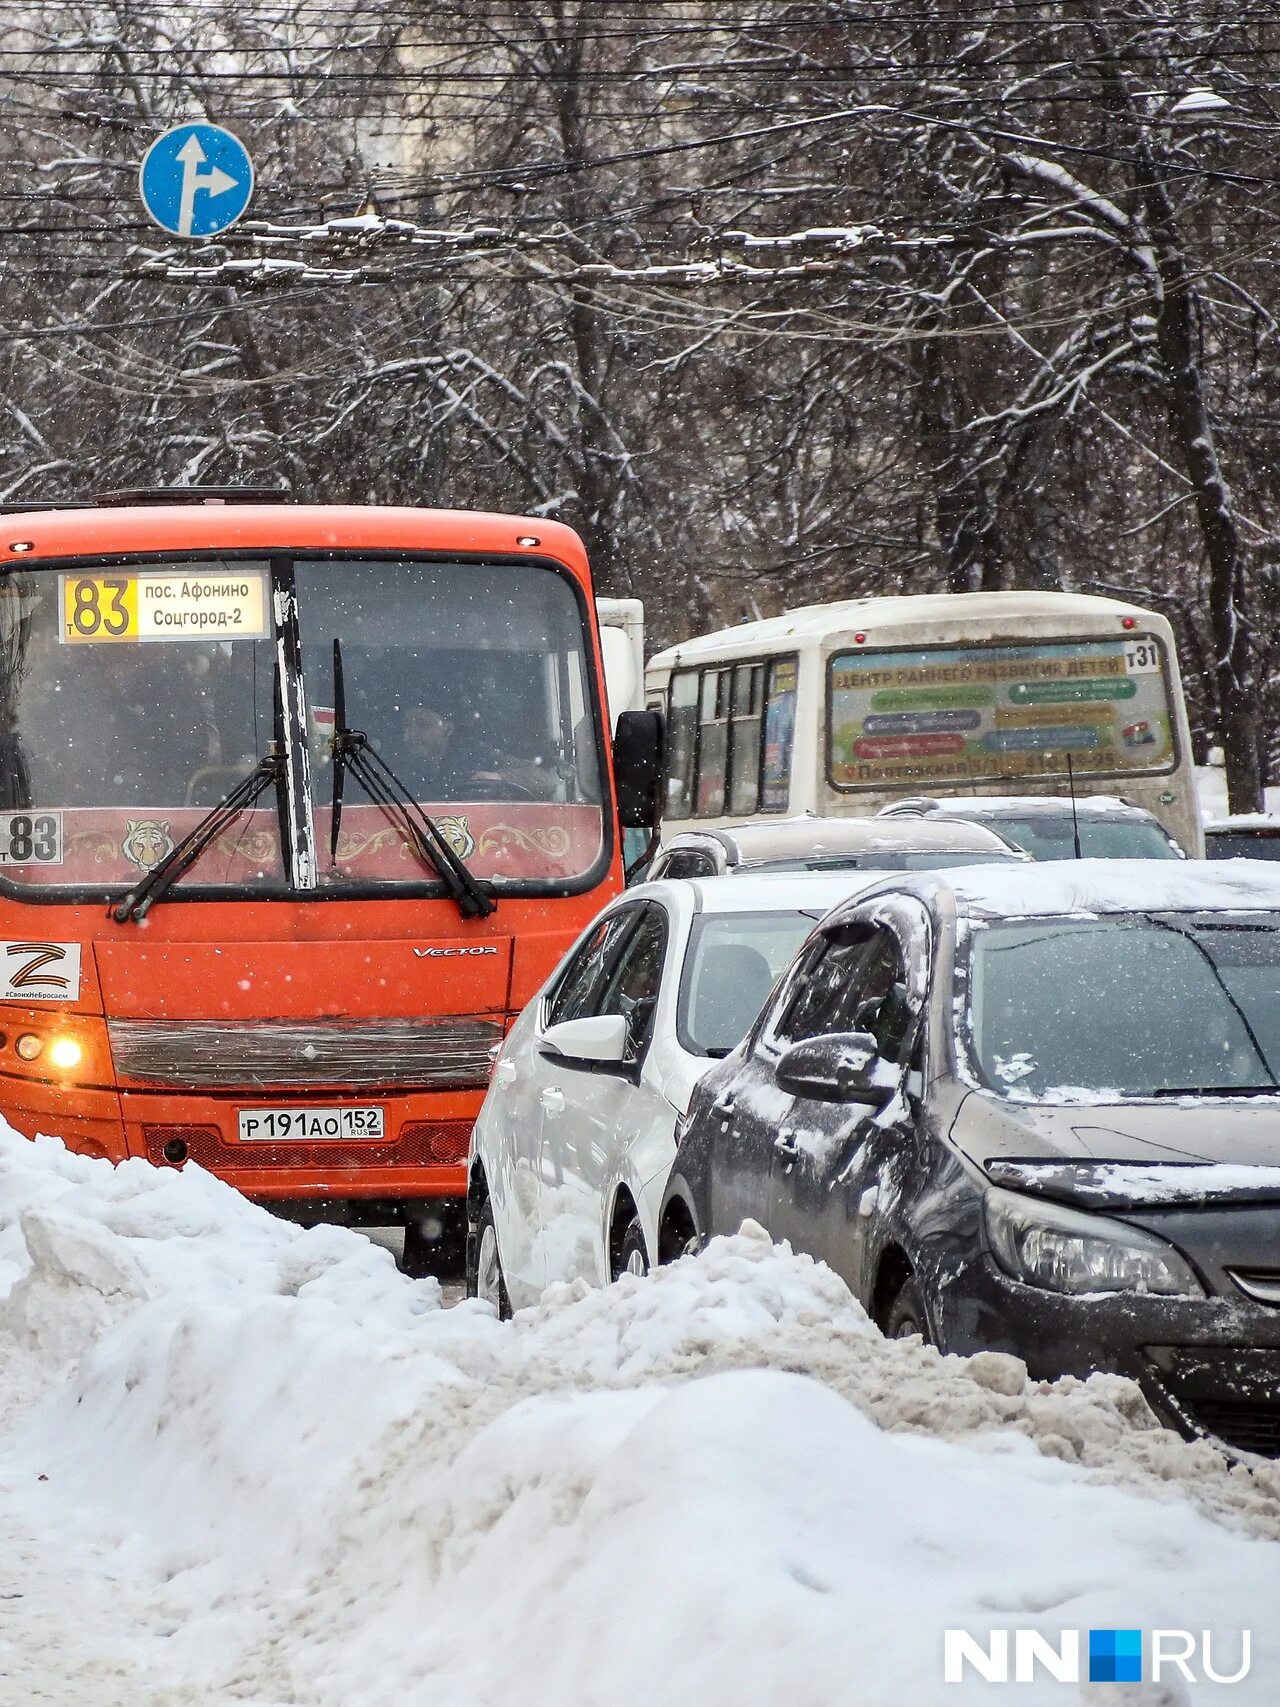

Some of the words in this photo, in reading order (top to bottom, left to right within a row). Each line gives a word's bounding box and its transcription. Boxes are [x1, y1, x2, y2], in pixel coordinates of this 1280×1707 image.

[145, 583, 176, 599] пос.
[181, 581, 249, 601] Афонино
[153, 607, 243, 628] Соцгород-2
[838, 671, 893, 689] ЦЕНТР
[898, 667, 972, 684] РАННЕГО
[1067, 660, 1119, 676] ДЕТЕЙ
[5, 990, 69, 999] #СвоихНеБросаем
[343, 1111, 378, 1129] 152
[350, 1128, 368, 1136] RUS
